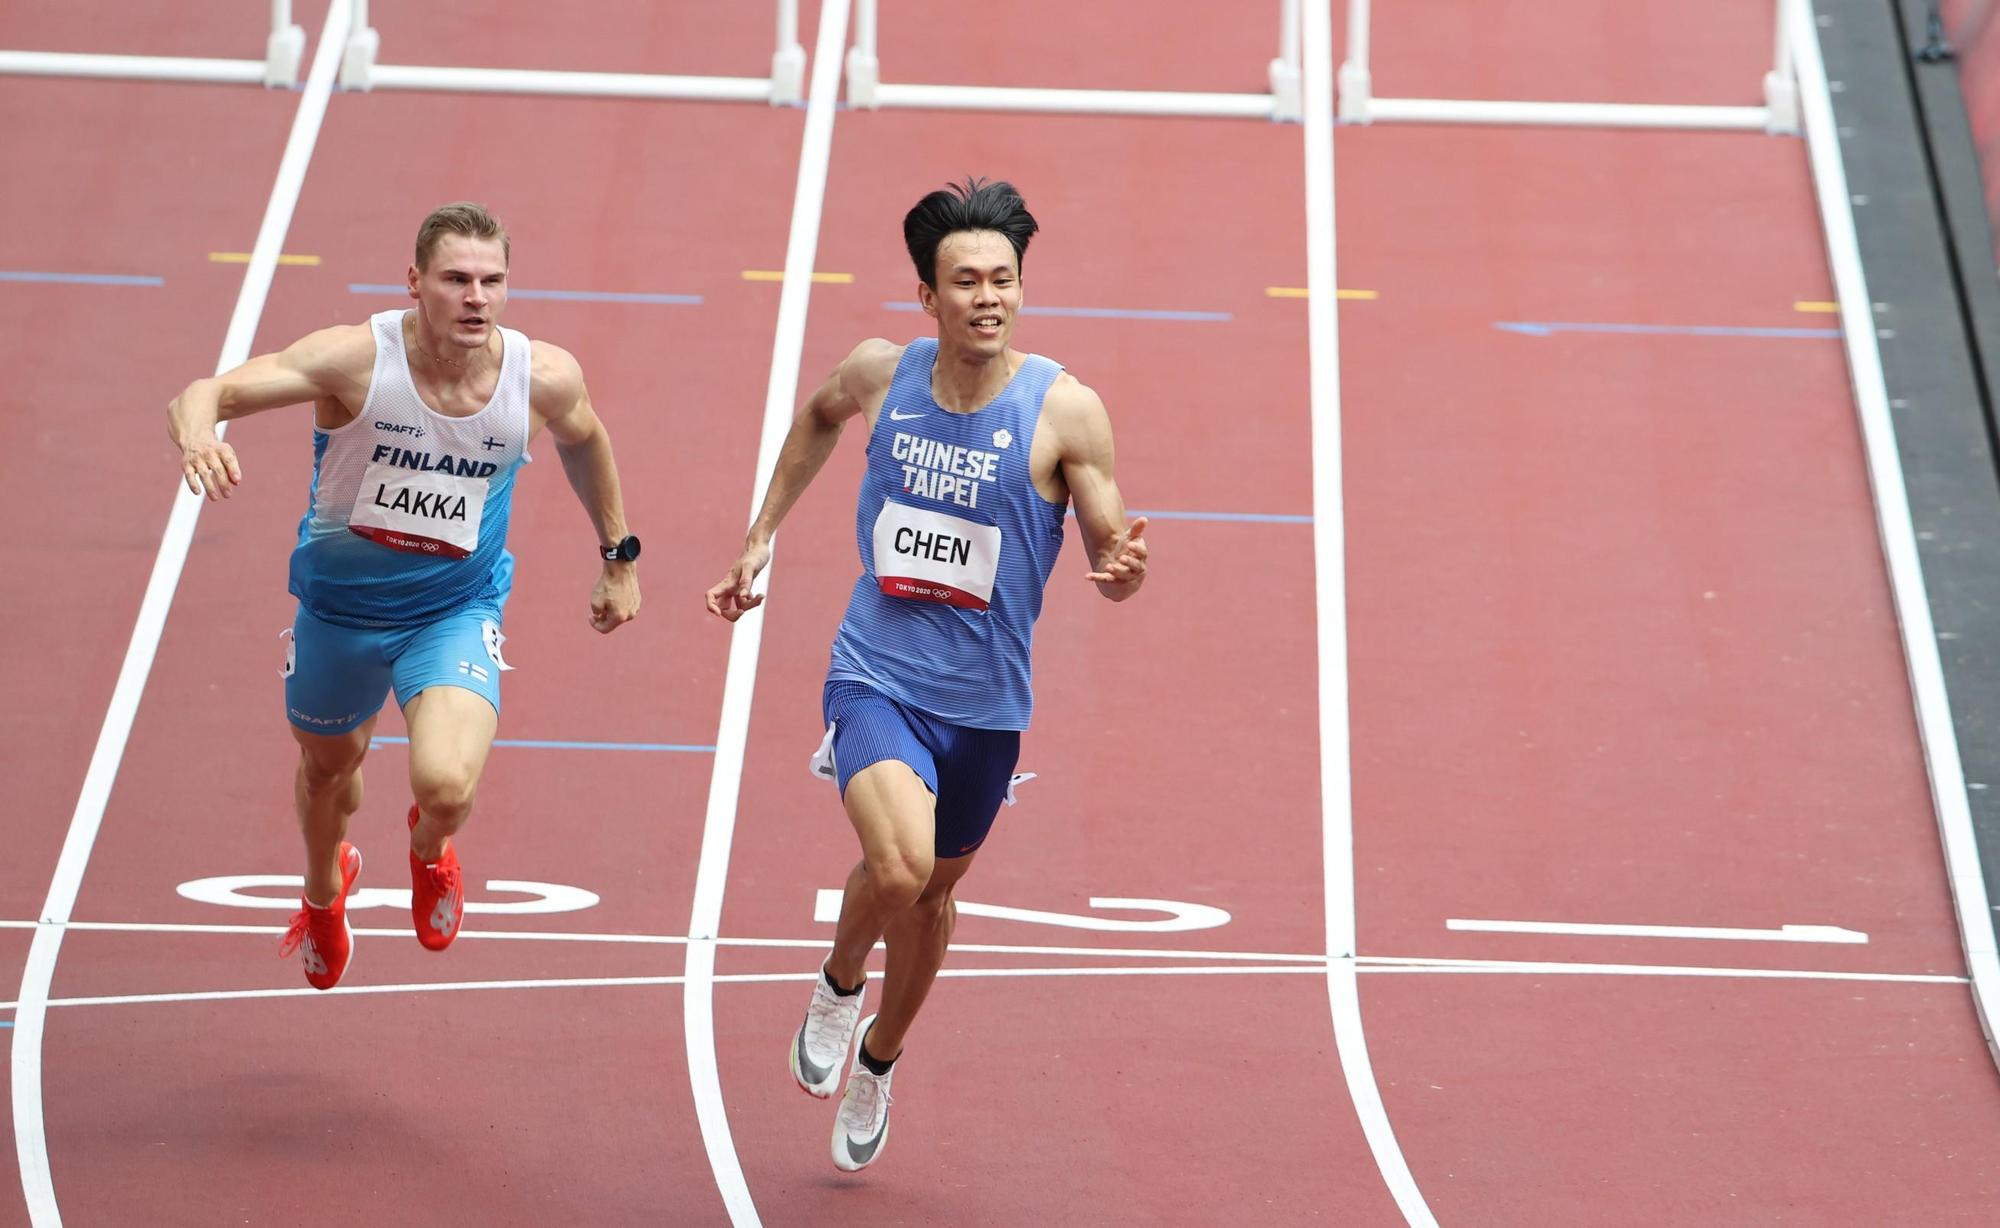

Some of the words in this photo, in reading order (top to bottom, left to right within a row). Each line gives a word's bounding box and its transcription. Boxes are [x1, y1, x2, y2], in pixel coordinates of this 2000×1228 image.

[374, 421, 416, 436] CRAFT
[371, 444, 498, 478] FINLAND
[891, 432, 1000, 482] CHINESE
[374, 483, 467, 521] LAKKA
[901, 464, 979, 509] TAIPEI
[386, 535, 405, 546] TOKYO
[893, 526, 972, 566] CHEN
[895, 582, 915, 593] TOKYO
[915, 587, 931, 595] 2020
[290, 707, 347, 725] CRAFT
[813, 888, 1232, 932] 2
[1445, 918, 1869, 944] 1
